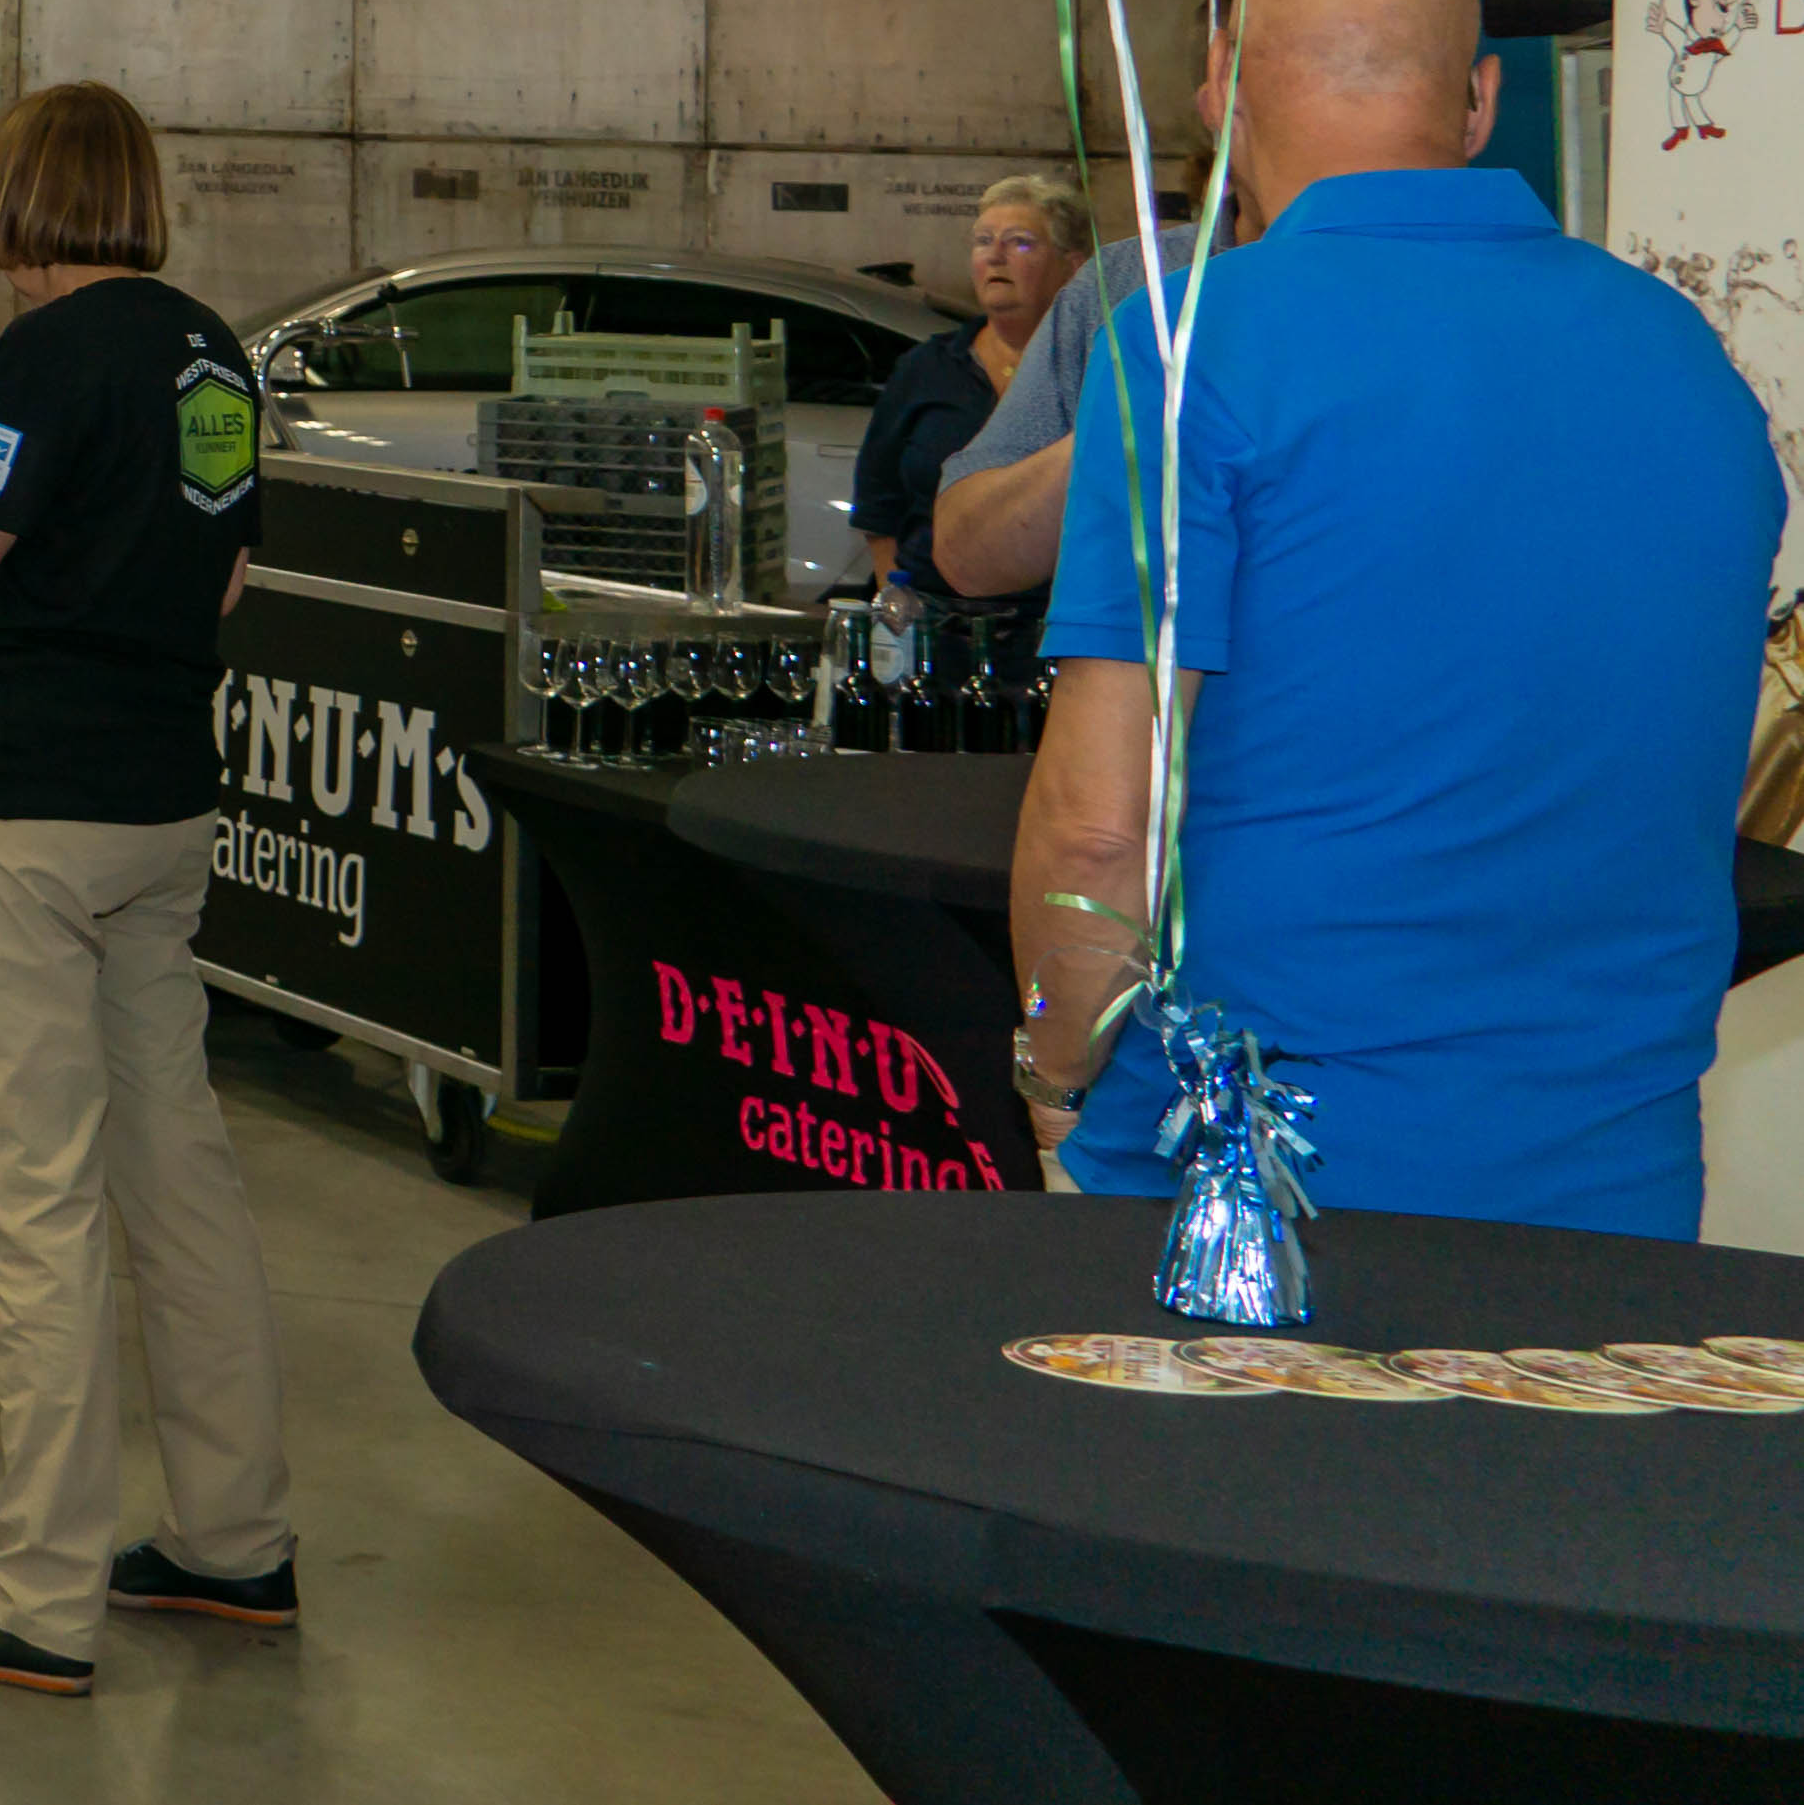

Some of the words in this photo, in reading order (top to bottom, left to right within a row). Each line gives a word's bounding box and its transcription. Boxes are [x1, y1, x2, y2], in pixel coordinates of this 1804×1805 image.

[185, 333, 208, 348] DE
[186, 412, 246, 438] ALLES
[212, 808, 366, 948] atering
